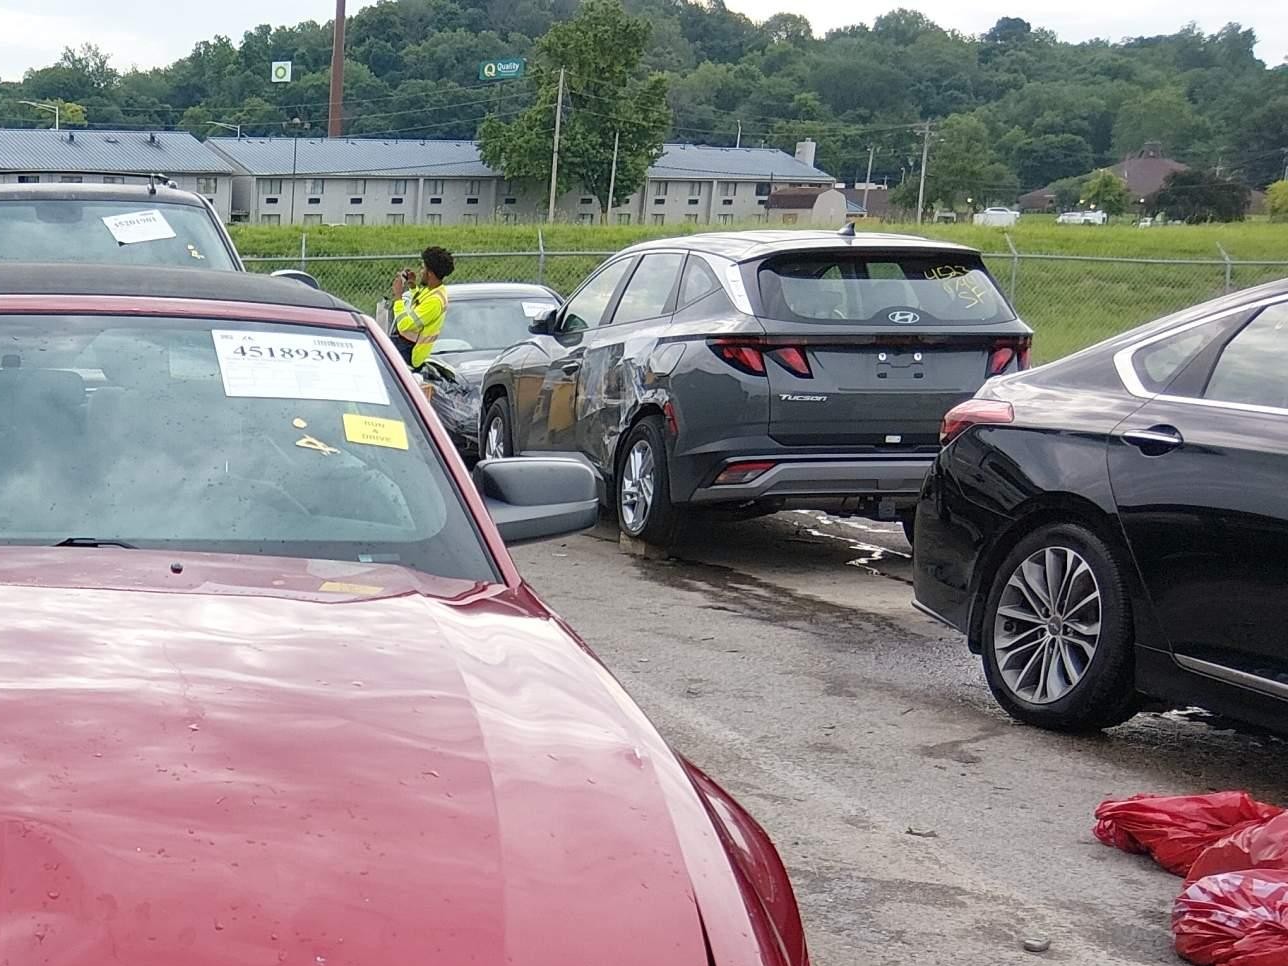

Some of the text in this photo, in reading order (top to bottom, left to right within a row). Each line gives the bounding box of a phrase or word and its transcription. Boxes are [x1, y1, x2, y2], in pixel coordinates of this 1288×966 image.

[497, 62, 519, 73] Quality
[233, 345, 354, 364] 45189307
[779, 394, 828, 402] Tucson
